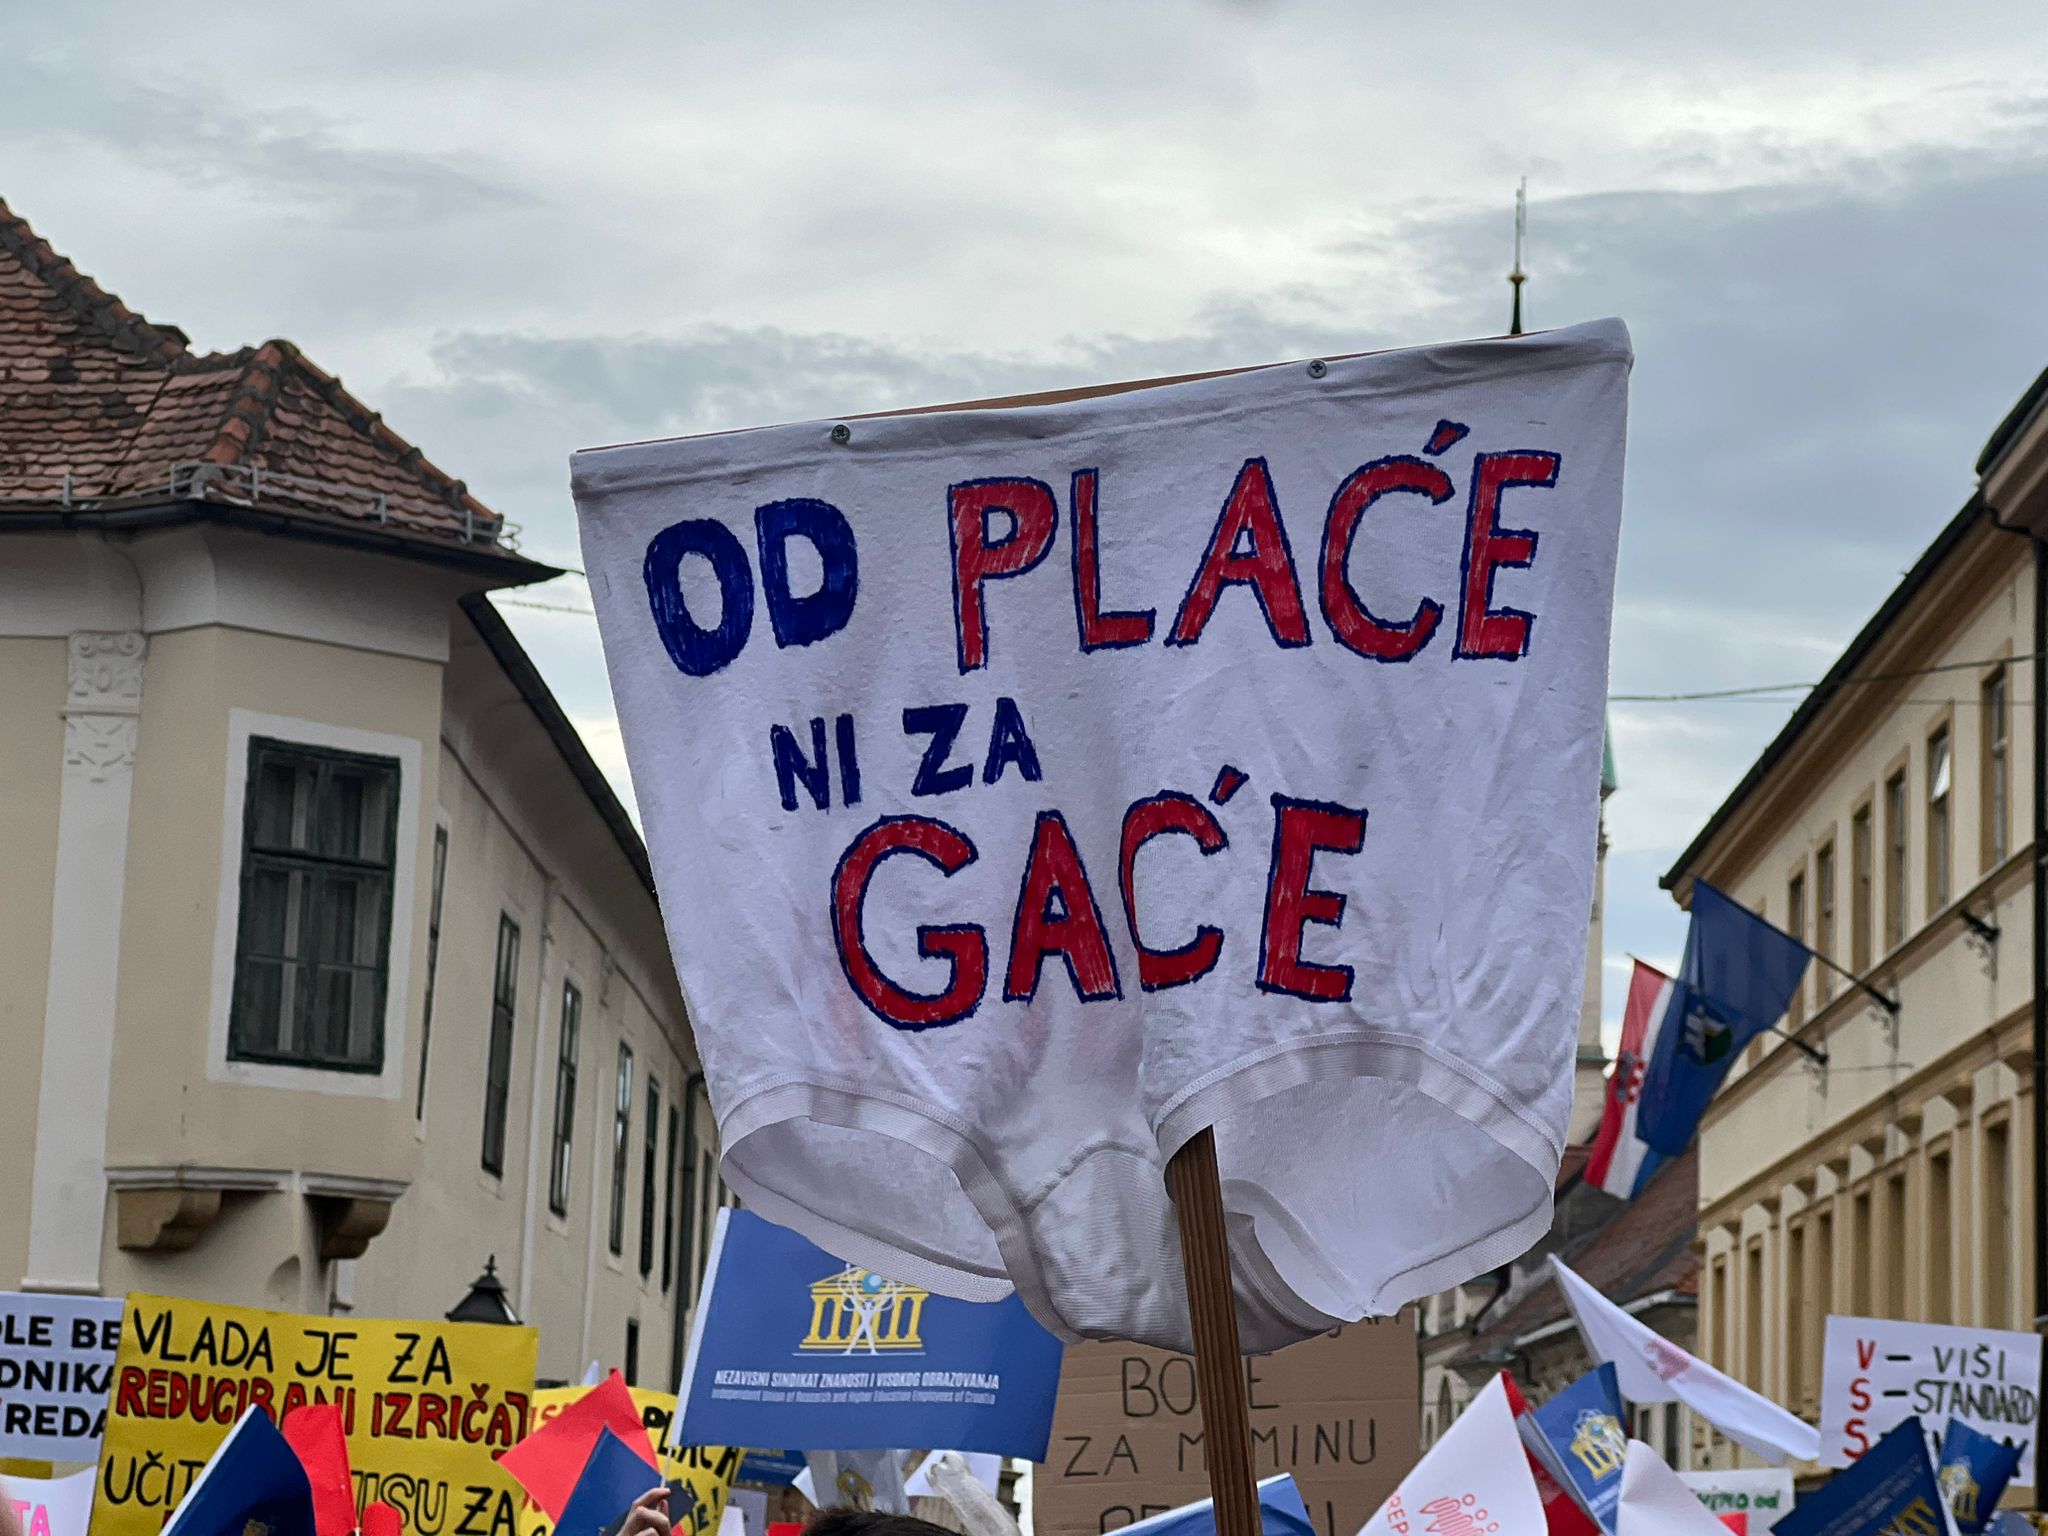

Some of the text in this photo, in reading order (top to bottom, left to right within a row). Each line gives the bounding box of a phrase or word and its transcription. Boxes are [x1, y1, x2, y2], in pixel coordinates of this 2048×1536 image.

[643, 418, 1562, 677] OD PLAĆE
[770, 697, 1042, 811] NI ZA
[830, 765, 1369, 1031] GAĆE
[0, 1314, 54, 1347] LE
[133, 1308, 453, 1384] VLADA JE ZA
[1857, 1338, 1876, 1371] V
[1933, 1342, 2006, 1381] VIŠI
[714, 1370, 771, 1387] NEZAVISNI
[771, 1372, 820, 1388] SINDIKAT
[876, 1372, 921, 1388] VISOKOG
[921, 1371, 1000, 1390] OBRAZOVANJA
[1121, 1355, 1281, 1418] BOE
[1850, 1377, 1873, 1413] S
[1913, 1378, 2040, 1426] STANDARD
[371, 1383, 530, 1461] IZRIČAJ
[1064, 1418, 1377, 1478] ZA MMINU
[1842, 1418, 1871, 1461] S
[454, 1485, 517, 1536] ZA
